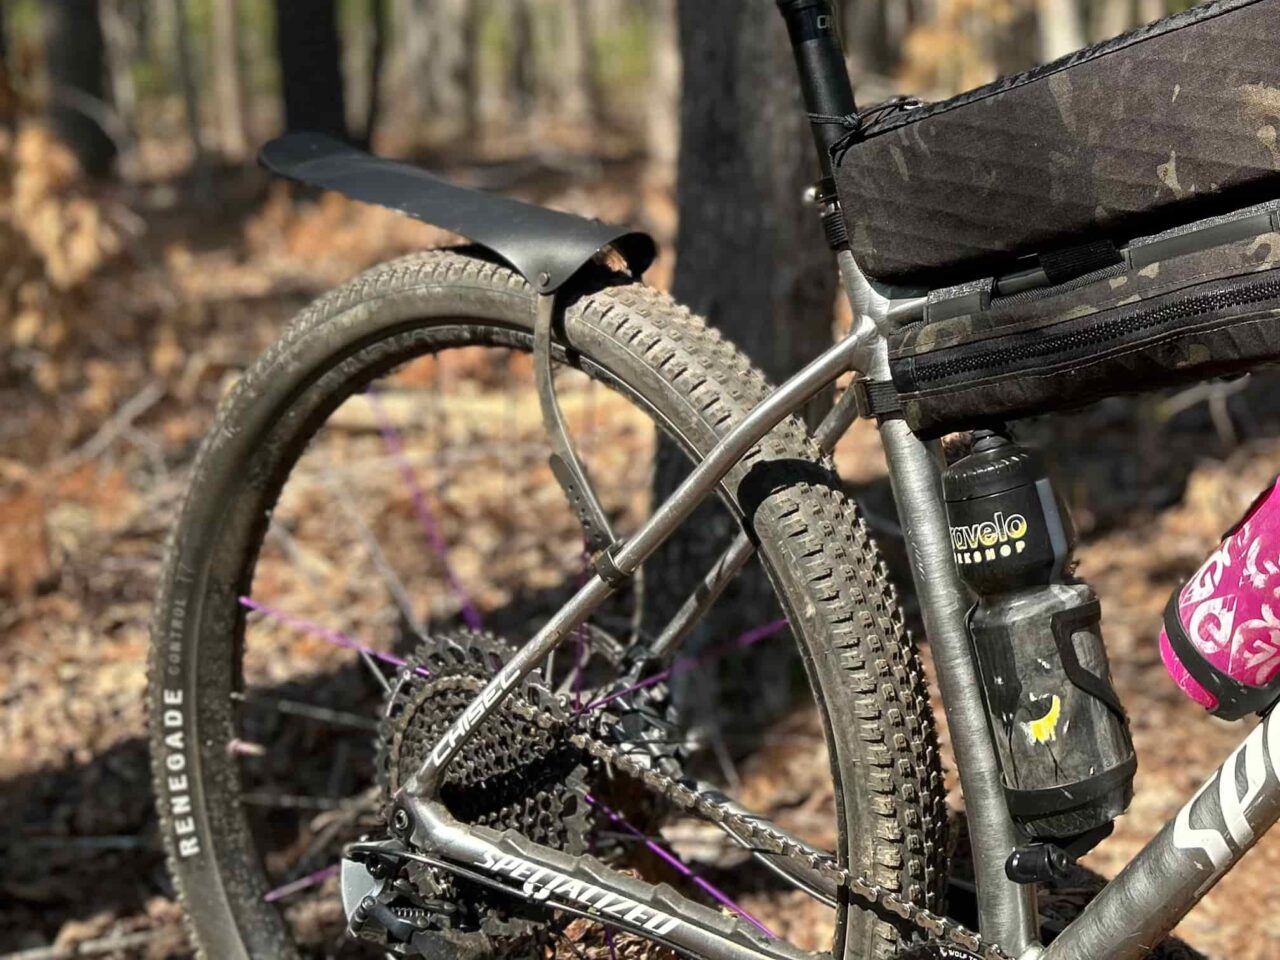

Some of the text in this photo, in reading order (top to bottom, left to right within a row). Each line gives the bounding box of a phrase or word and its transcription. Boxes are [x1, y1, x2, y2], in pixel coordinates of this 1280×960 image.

[168, 599, 187, 676] CONTROL
[433, 668, 520, 767] CHISEL
[163, 689, 200, 857] RENEGADE
[473, 849, 682, 935] SPECIALIZED
